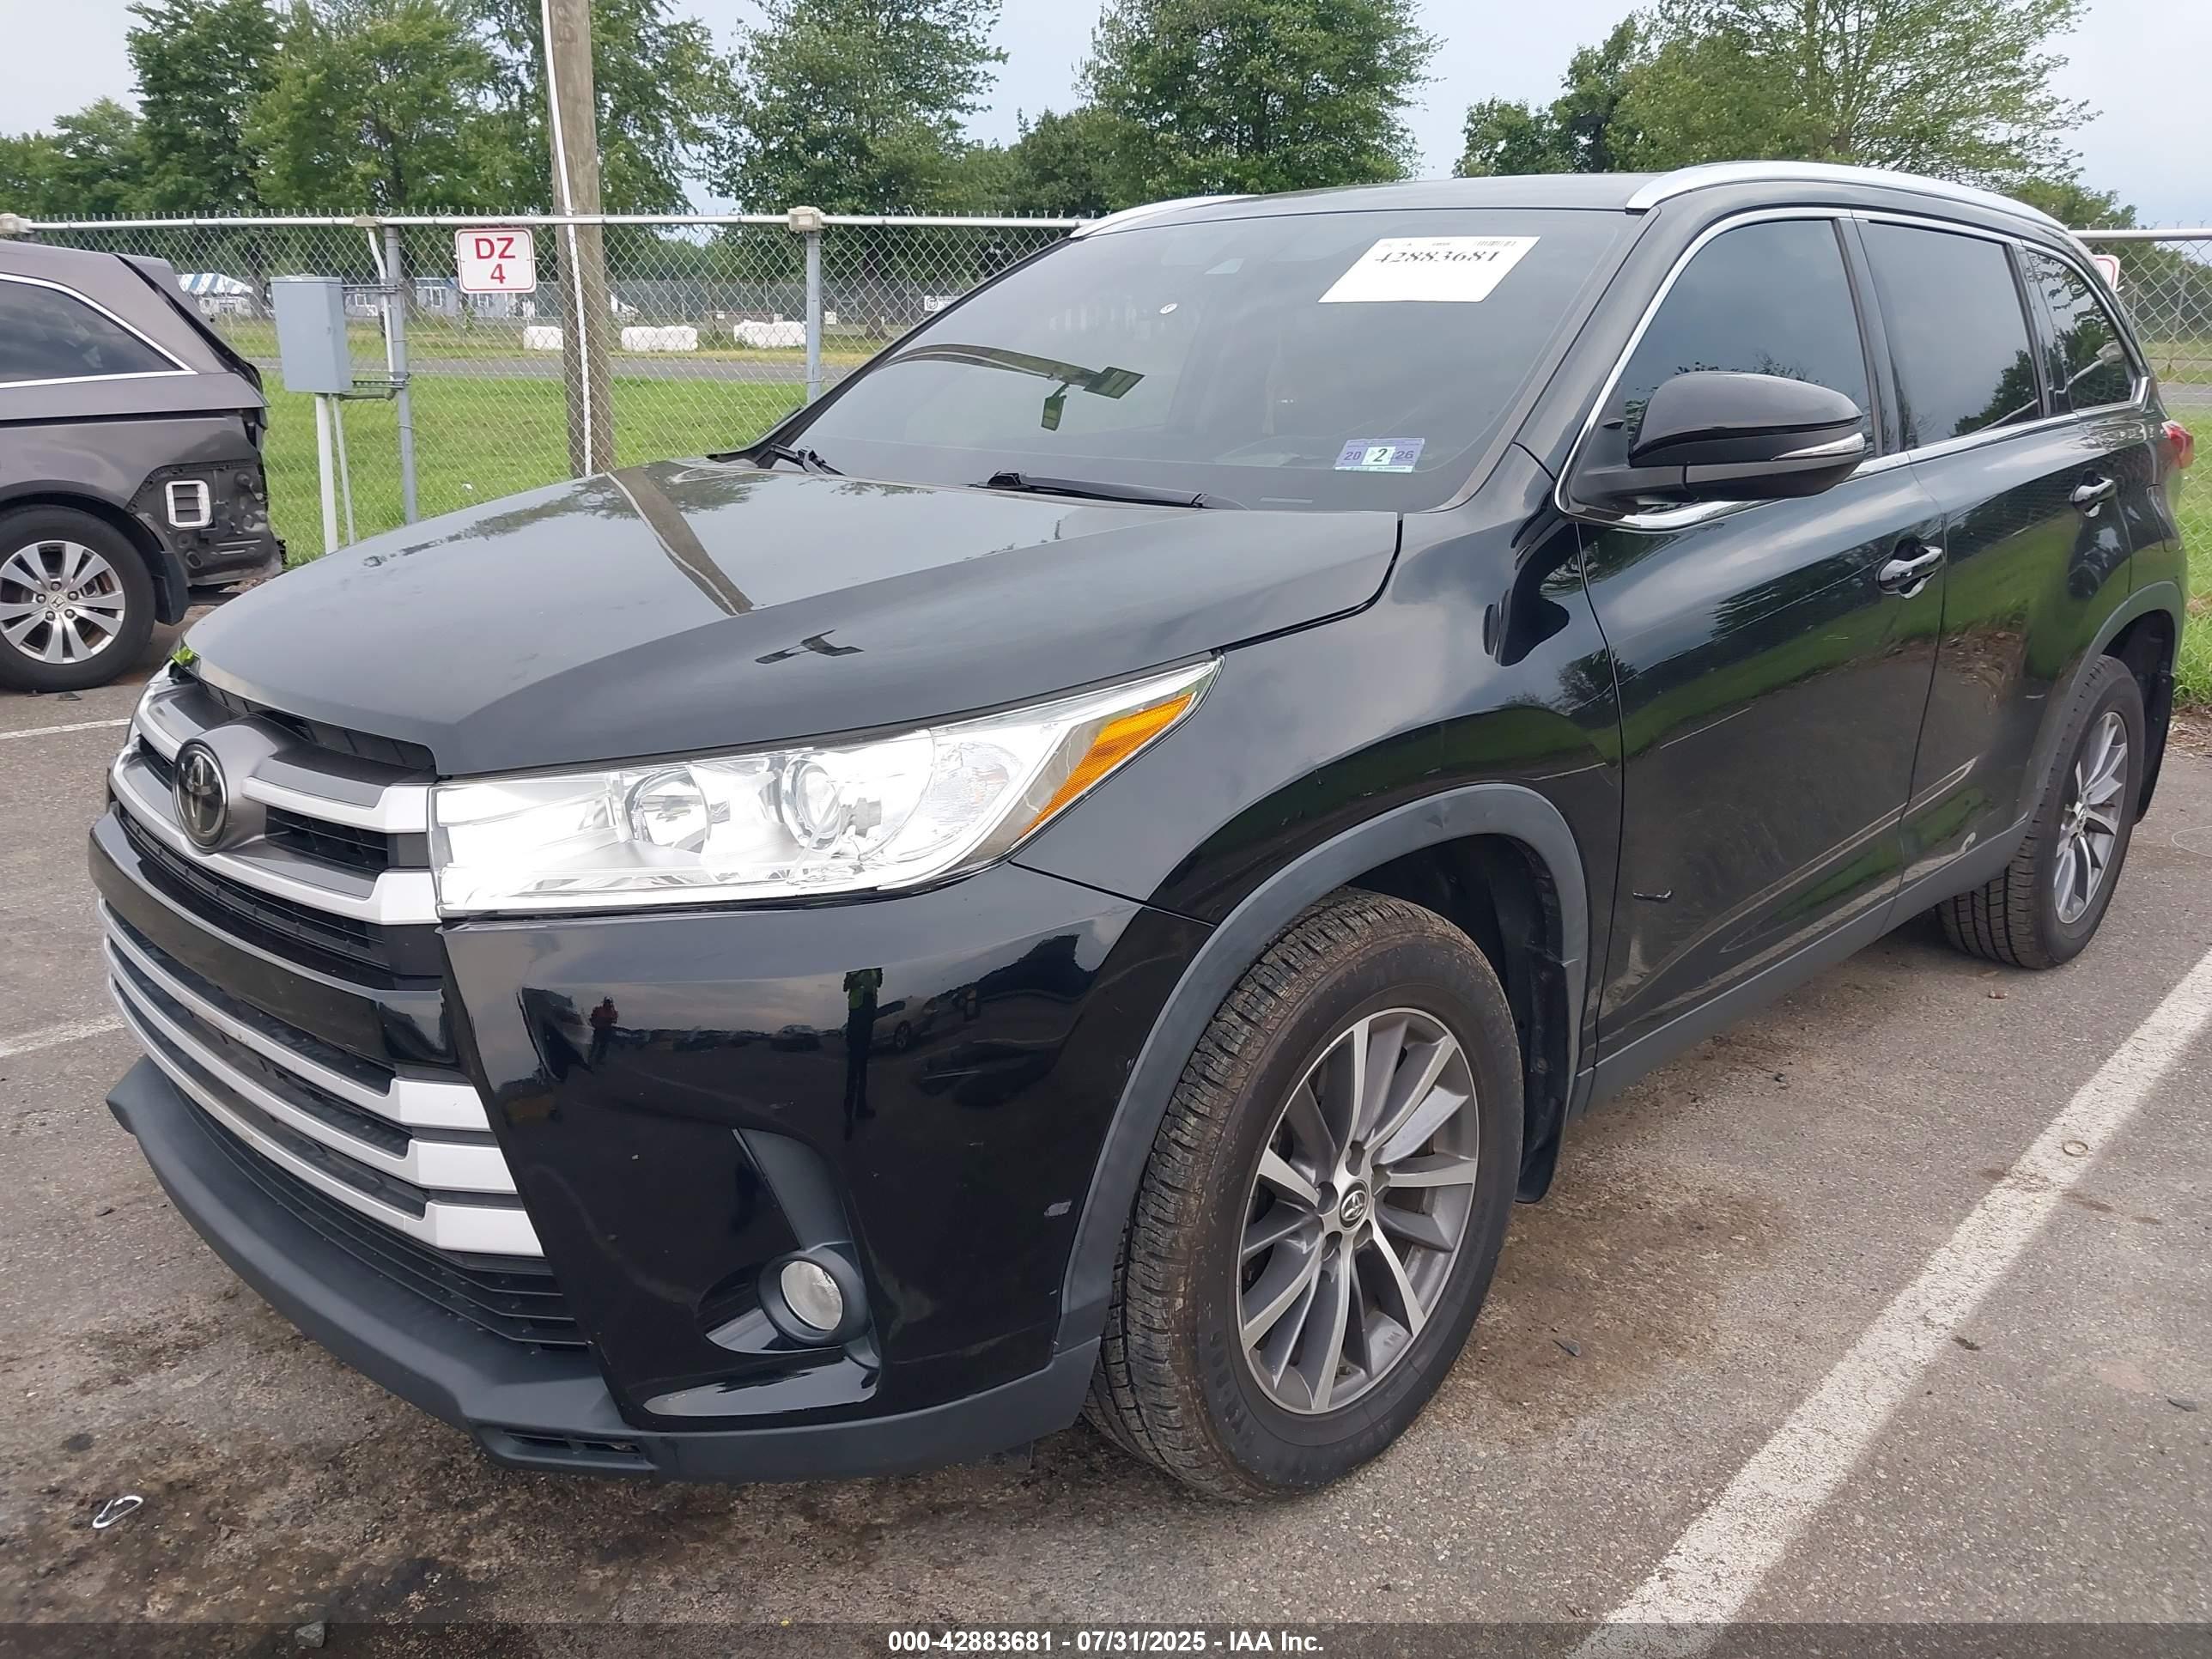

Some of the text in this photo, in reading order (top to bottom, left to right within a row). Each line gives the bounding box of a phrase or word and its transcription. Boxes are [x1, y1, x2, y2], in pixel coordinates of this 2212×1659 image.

[475, 237, 516, 259] DZ
[1375, 251, 1500, 263] 42883681
[490, 264, 506, 284] 4
[1344, 448, 1415, 462] 20 2 26
